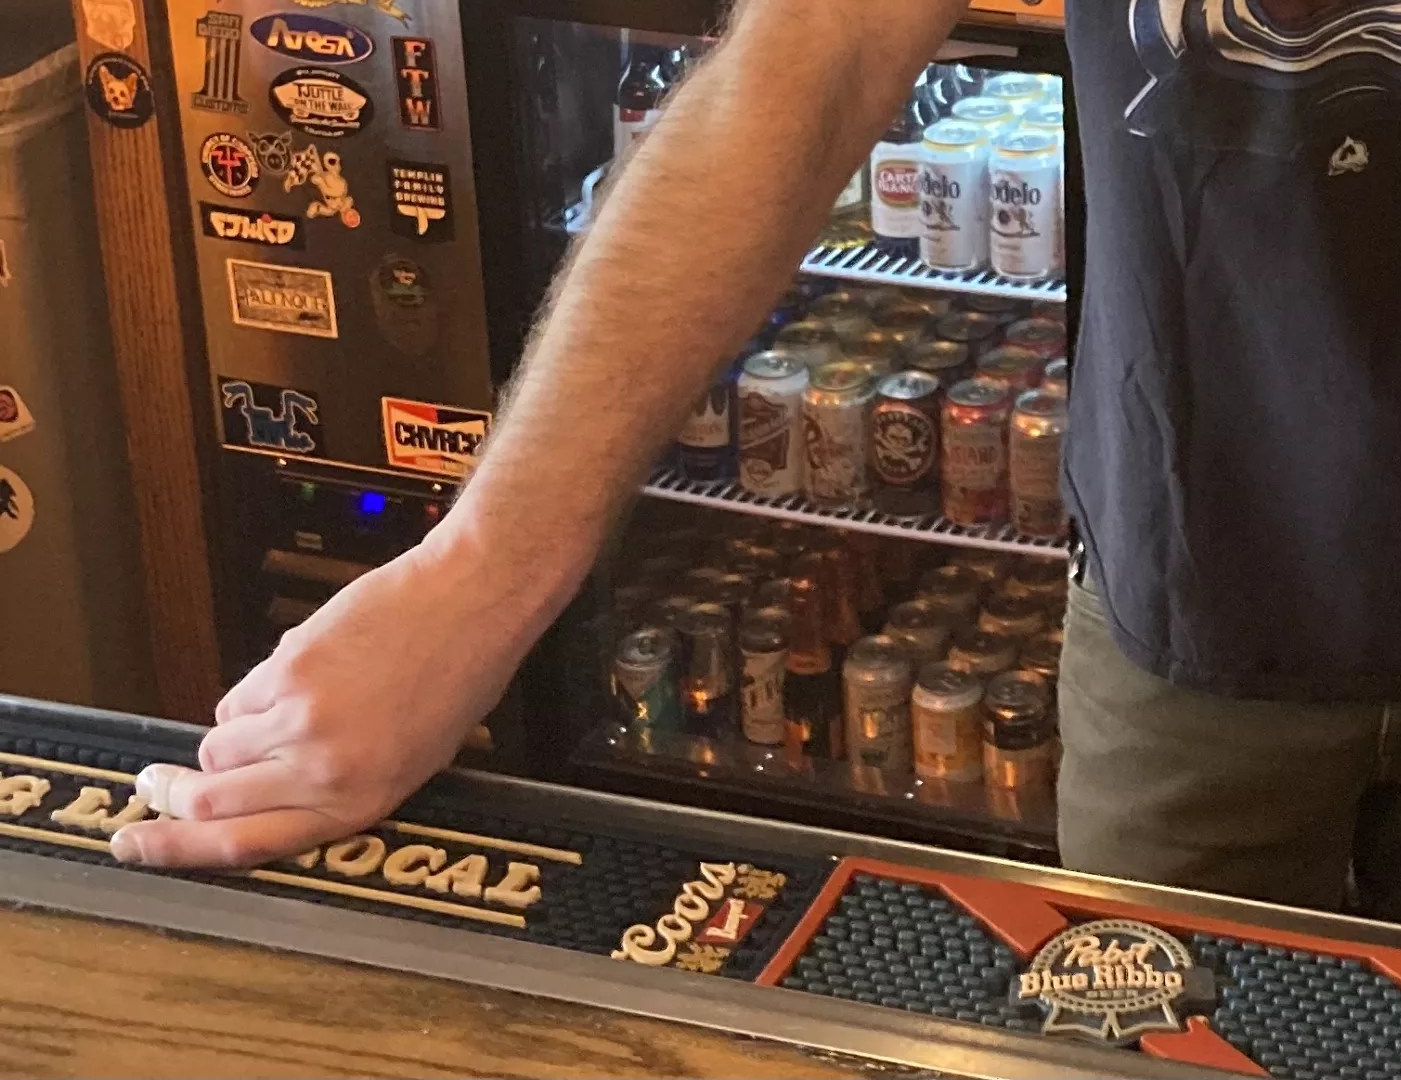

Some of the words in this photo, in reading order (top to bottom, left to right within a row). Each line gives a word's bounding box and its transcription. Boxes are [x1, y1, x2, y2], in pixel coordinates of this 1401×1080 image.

[392, 167, 444, 183] TEMPLIN
[393, 179, 445, 195] FAMILY
[296, 834, 543, 908] OCAL
[610, 860, 735, 966] Coors
[1063, 934, 1154, 968] Pabst
[1019, 967, 1089, 996] Blue
